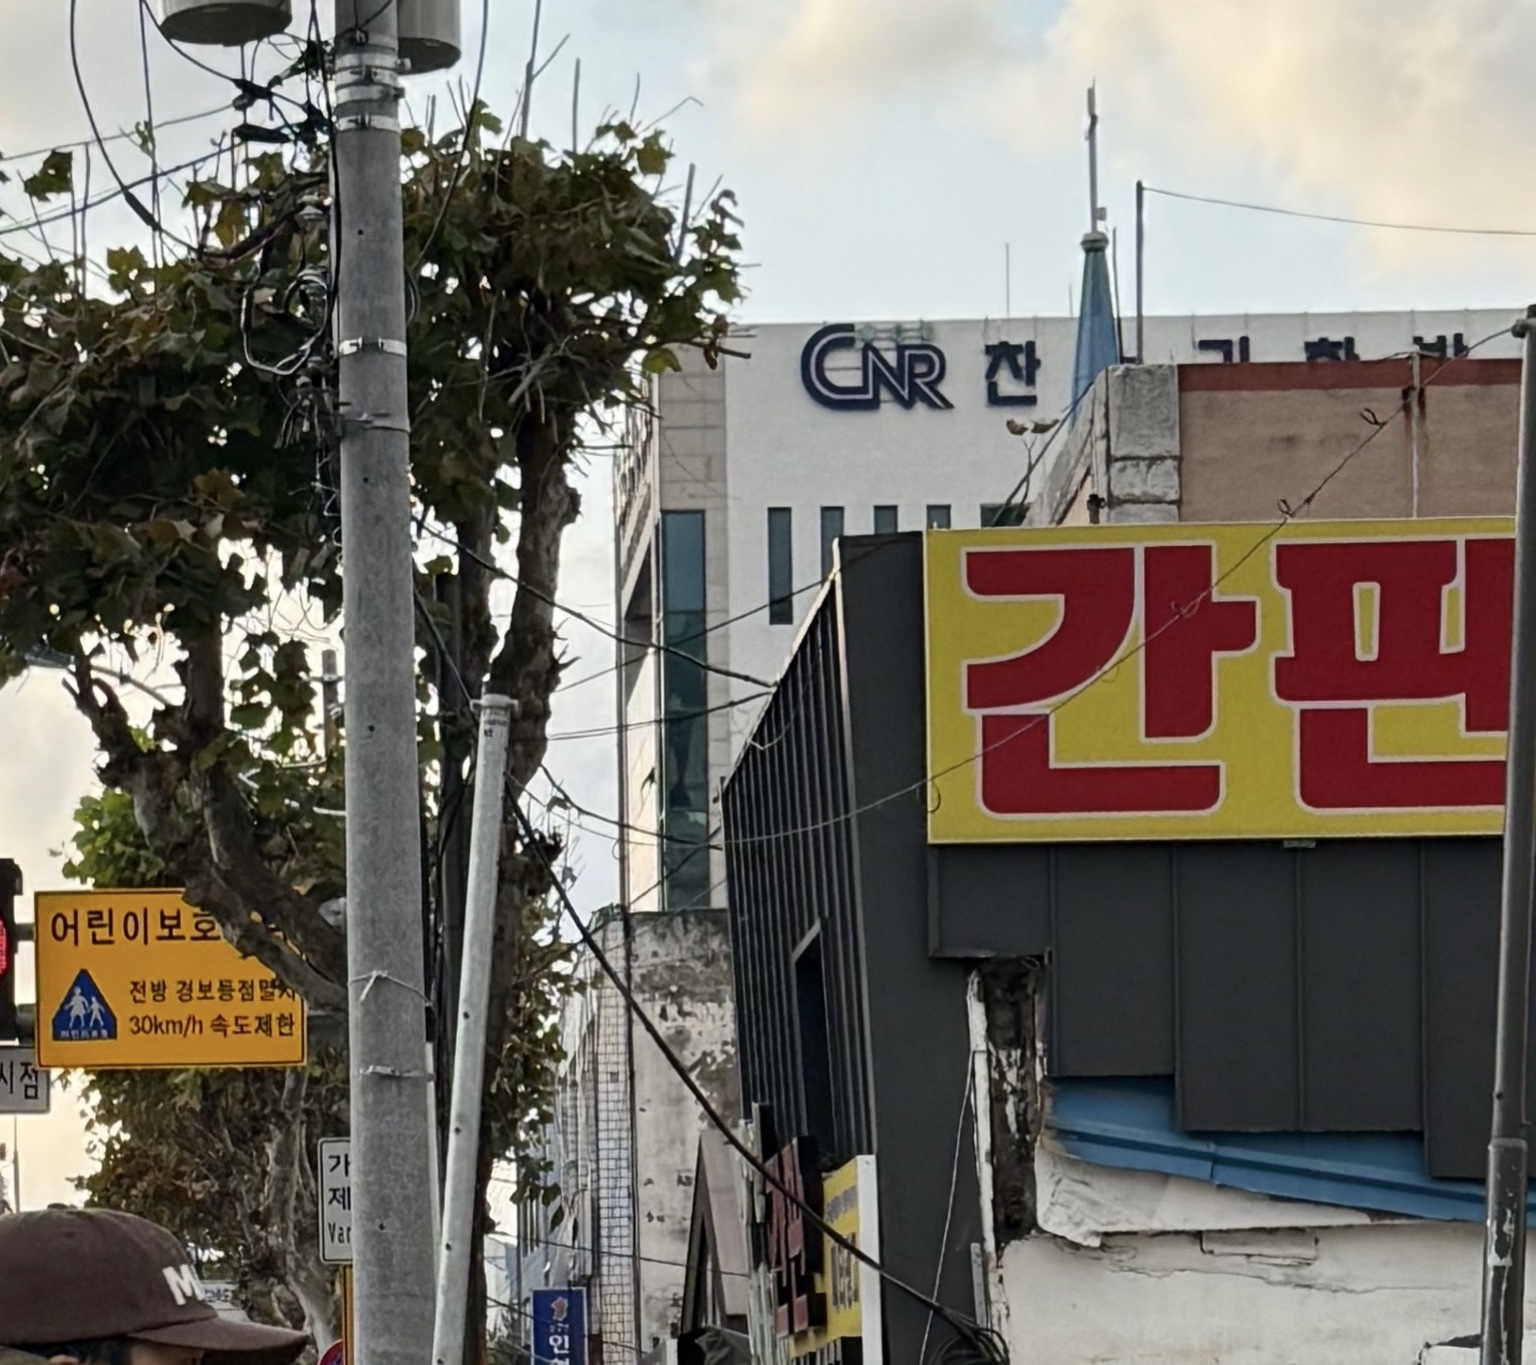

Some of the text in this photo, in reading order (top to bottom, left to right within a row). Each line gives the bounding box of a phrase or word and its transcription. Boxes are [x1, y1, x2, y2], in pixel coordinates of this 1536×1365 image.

[801, 323, 955, 410] CNR
[962, 537, 1515, 818] 간판
[129, 979, 167, 1003] 전방
[128, 1012, 296, 1038] 30km/h 속도제한
